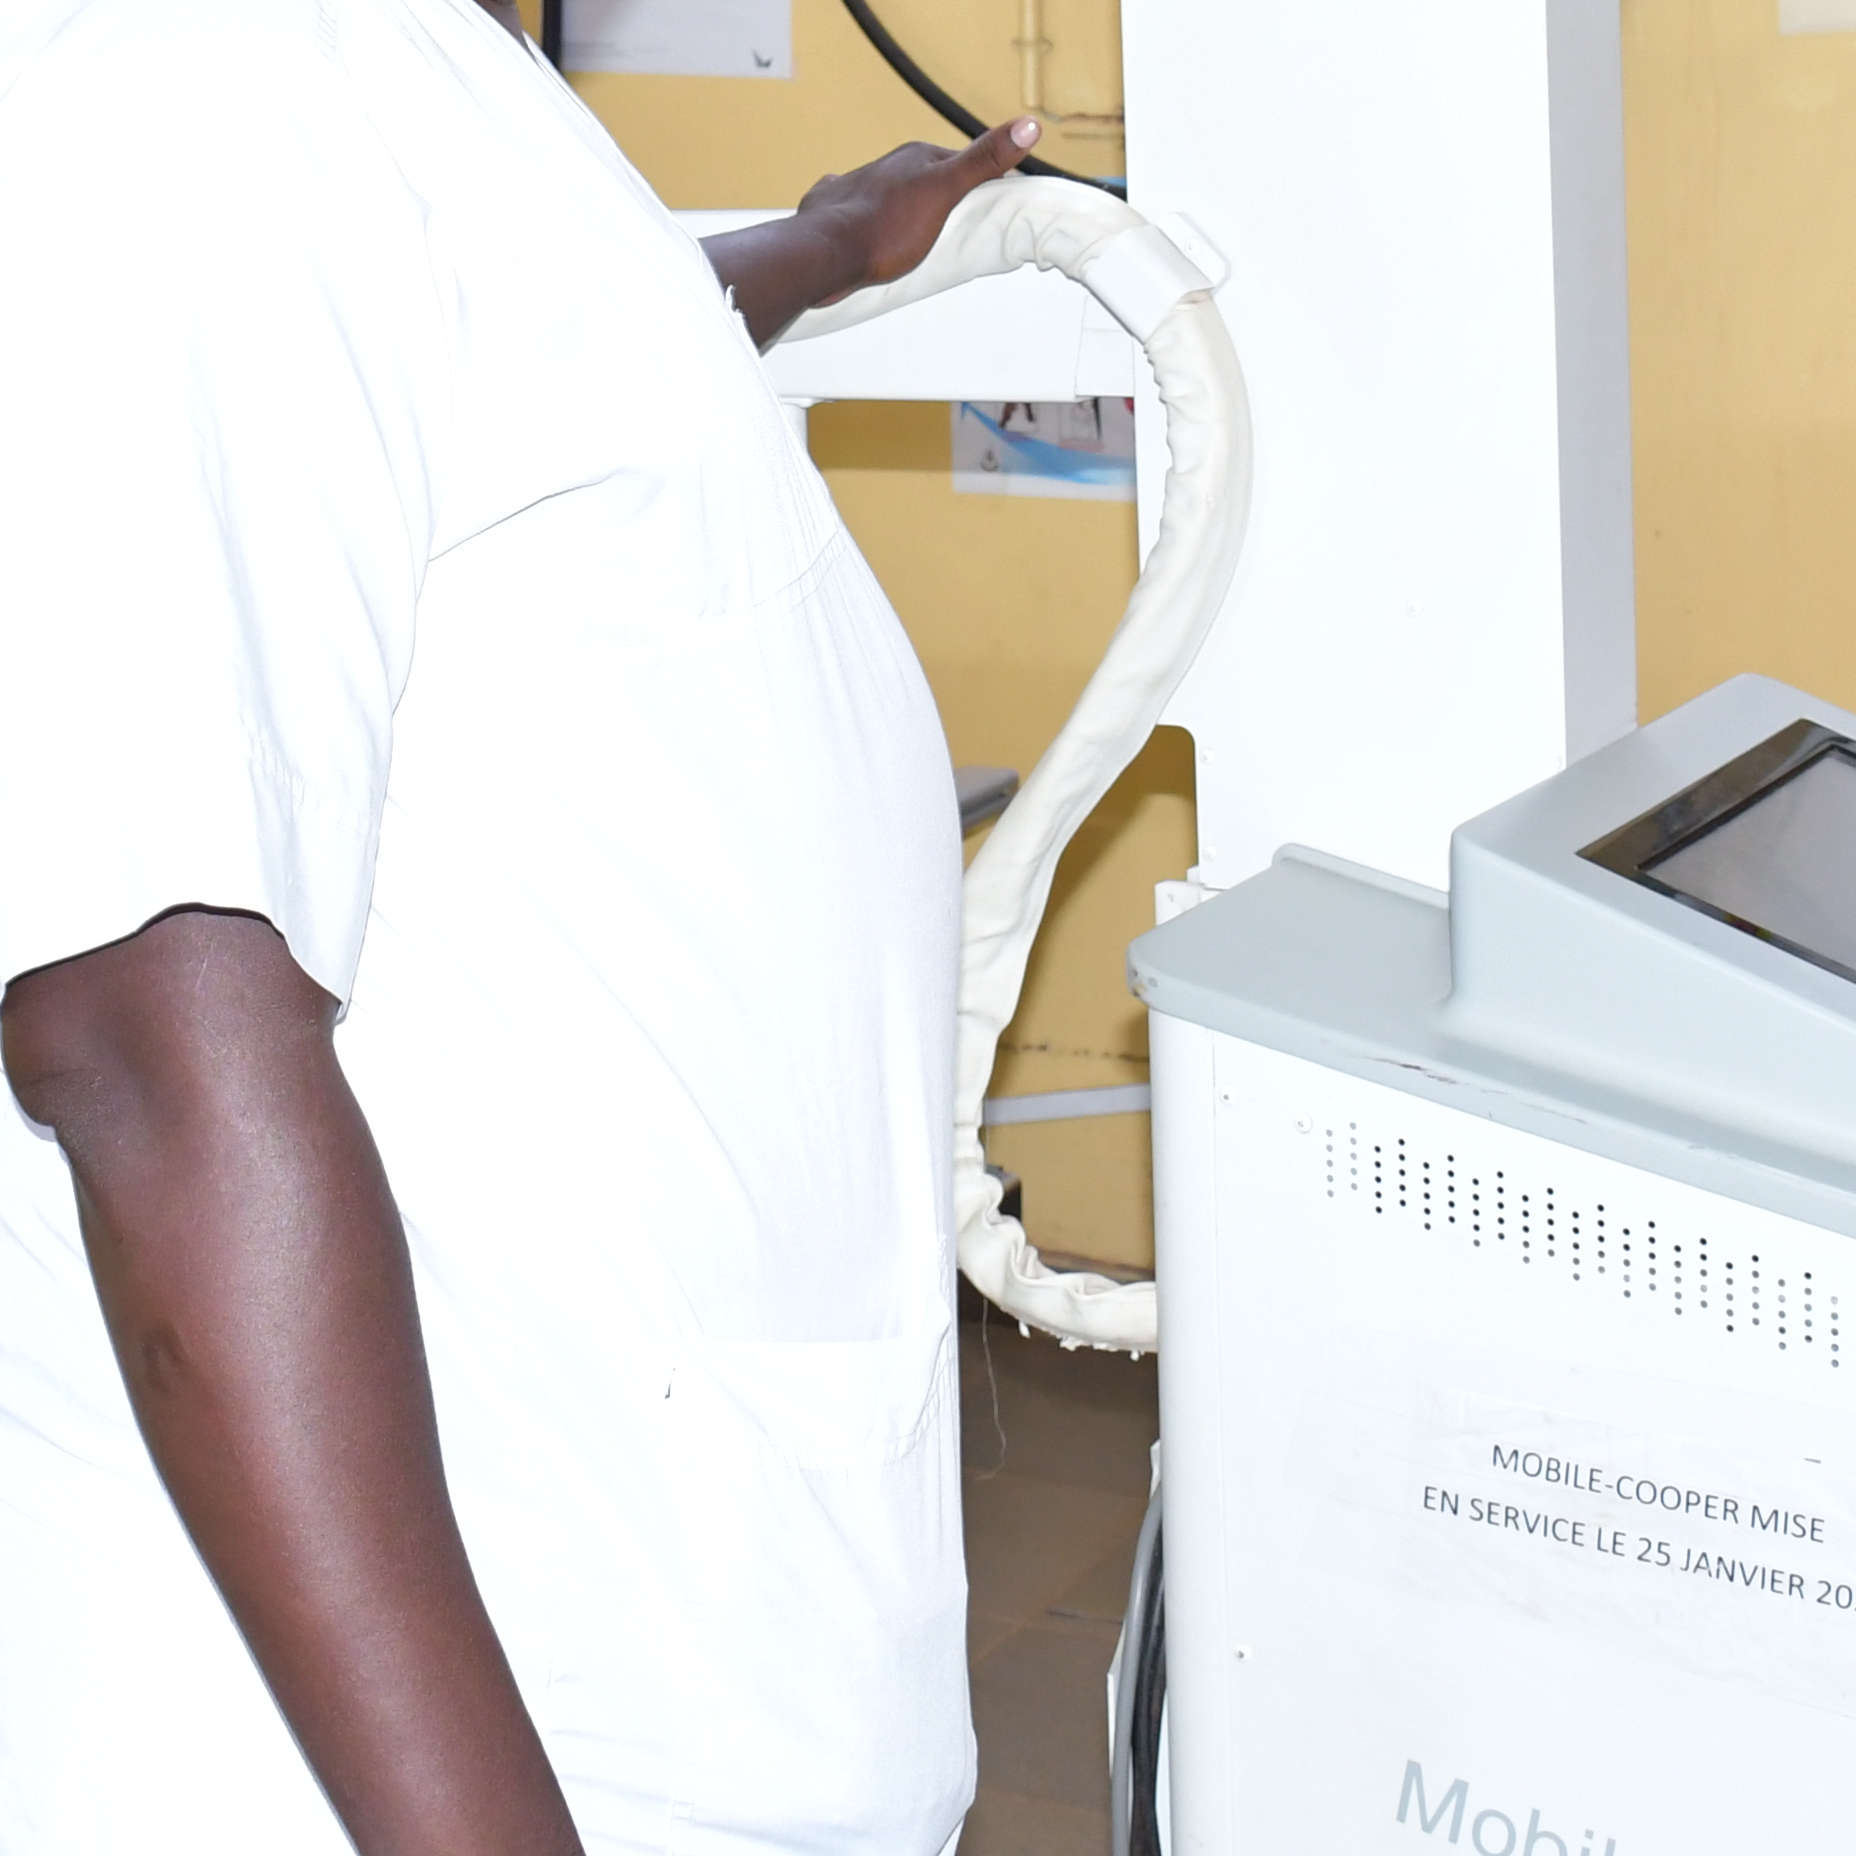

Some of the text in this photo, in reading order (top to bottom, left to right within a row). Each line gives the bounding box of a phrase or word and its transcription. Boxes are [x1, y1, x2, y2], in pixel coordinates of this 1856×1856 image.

[1422, 1485, 1459, 1517] EN
[1469, 1497, 1585, 1548] SERVICE
[1596, 1526, 1626, 1557] LE
[1637, 1536, 1672, 1568] 25
[1679, 1547, 1805, 1600] JANVIER
[1491, 1444, 1826, 1544] MOBILE-COOPER MISE
[1395, 1758, 1617, 1856] Mob
